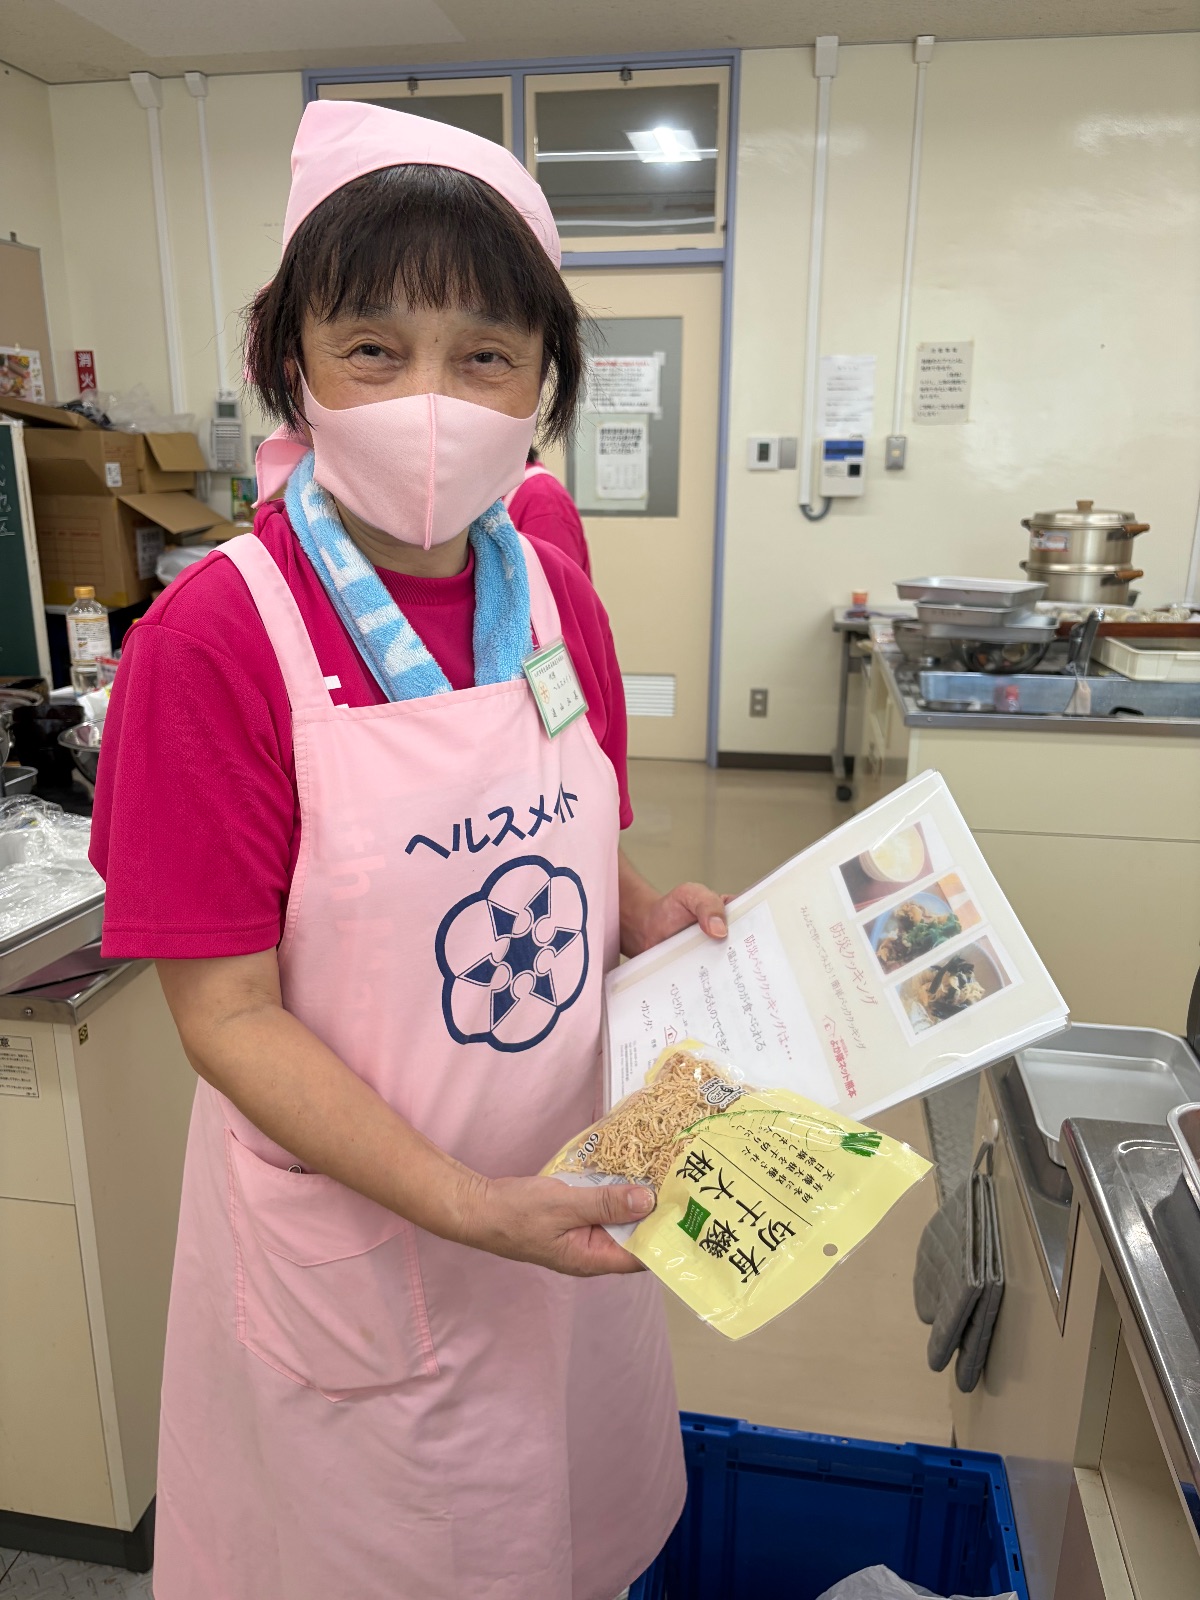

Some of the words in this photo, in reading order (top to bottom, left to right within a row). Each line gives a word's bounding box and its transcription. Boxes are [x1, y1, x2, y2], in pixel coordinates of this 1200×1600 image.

[829, 921, 879, 1006] 防災クッキング
[829, 1039, 857, 1099] よか隊ネット熊本
[577, 1132, 599, 1162] 60g
[742, 1146, 813, 1203] 初冬に収穫された
[759, 1125, 835, 1181] 天日乾燥しました。
[676, 1150, 796, 1251] 切干大根
[699, 1219, 766, 1283] 有機
